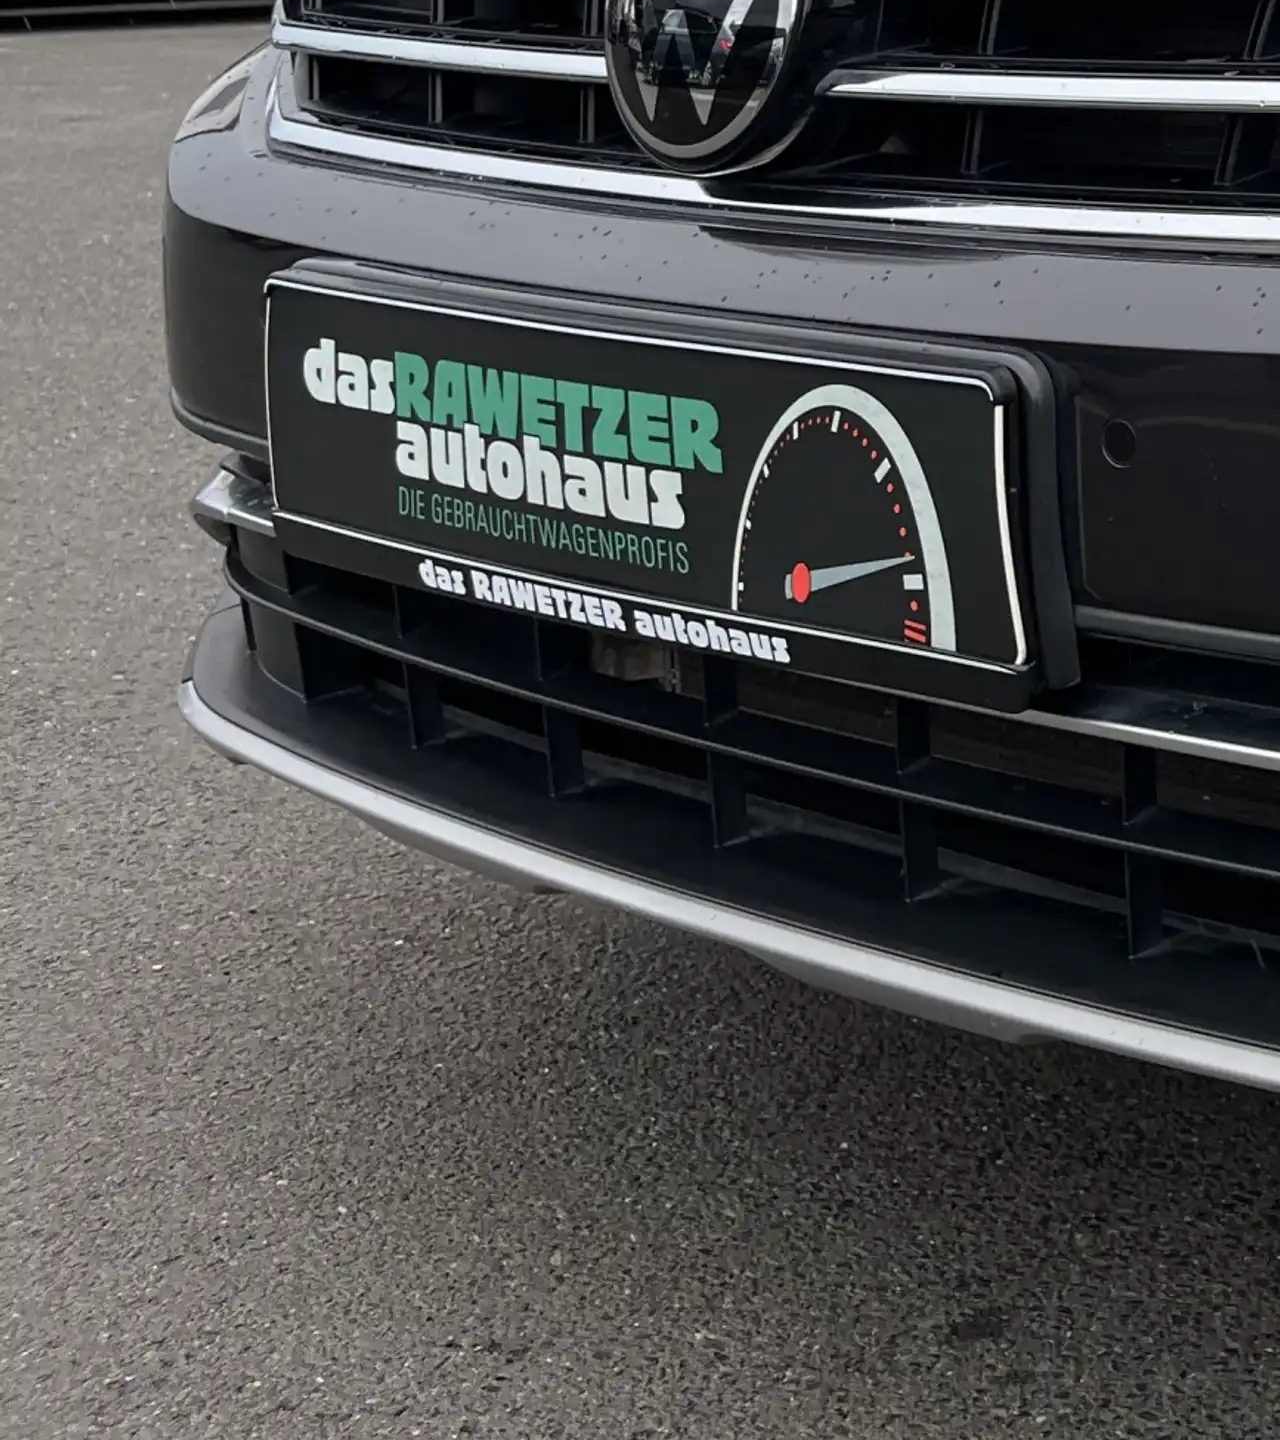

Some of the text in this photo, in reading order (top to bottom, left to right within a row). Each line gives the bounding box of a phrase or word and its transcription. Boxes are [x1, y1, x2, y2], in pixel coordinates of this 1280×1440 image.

[395, 420, 685, 530] autohaus
[398, 486, 691, 575] DIE GEBRAUCHTWAGENPROFIS
[418, 558, 791, 664] das RAWETZER autohaus
